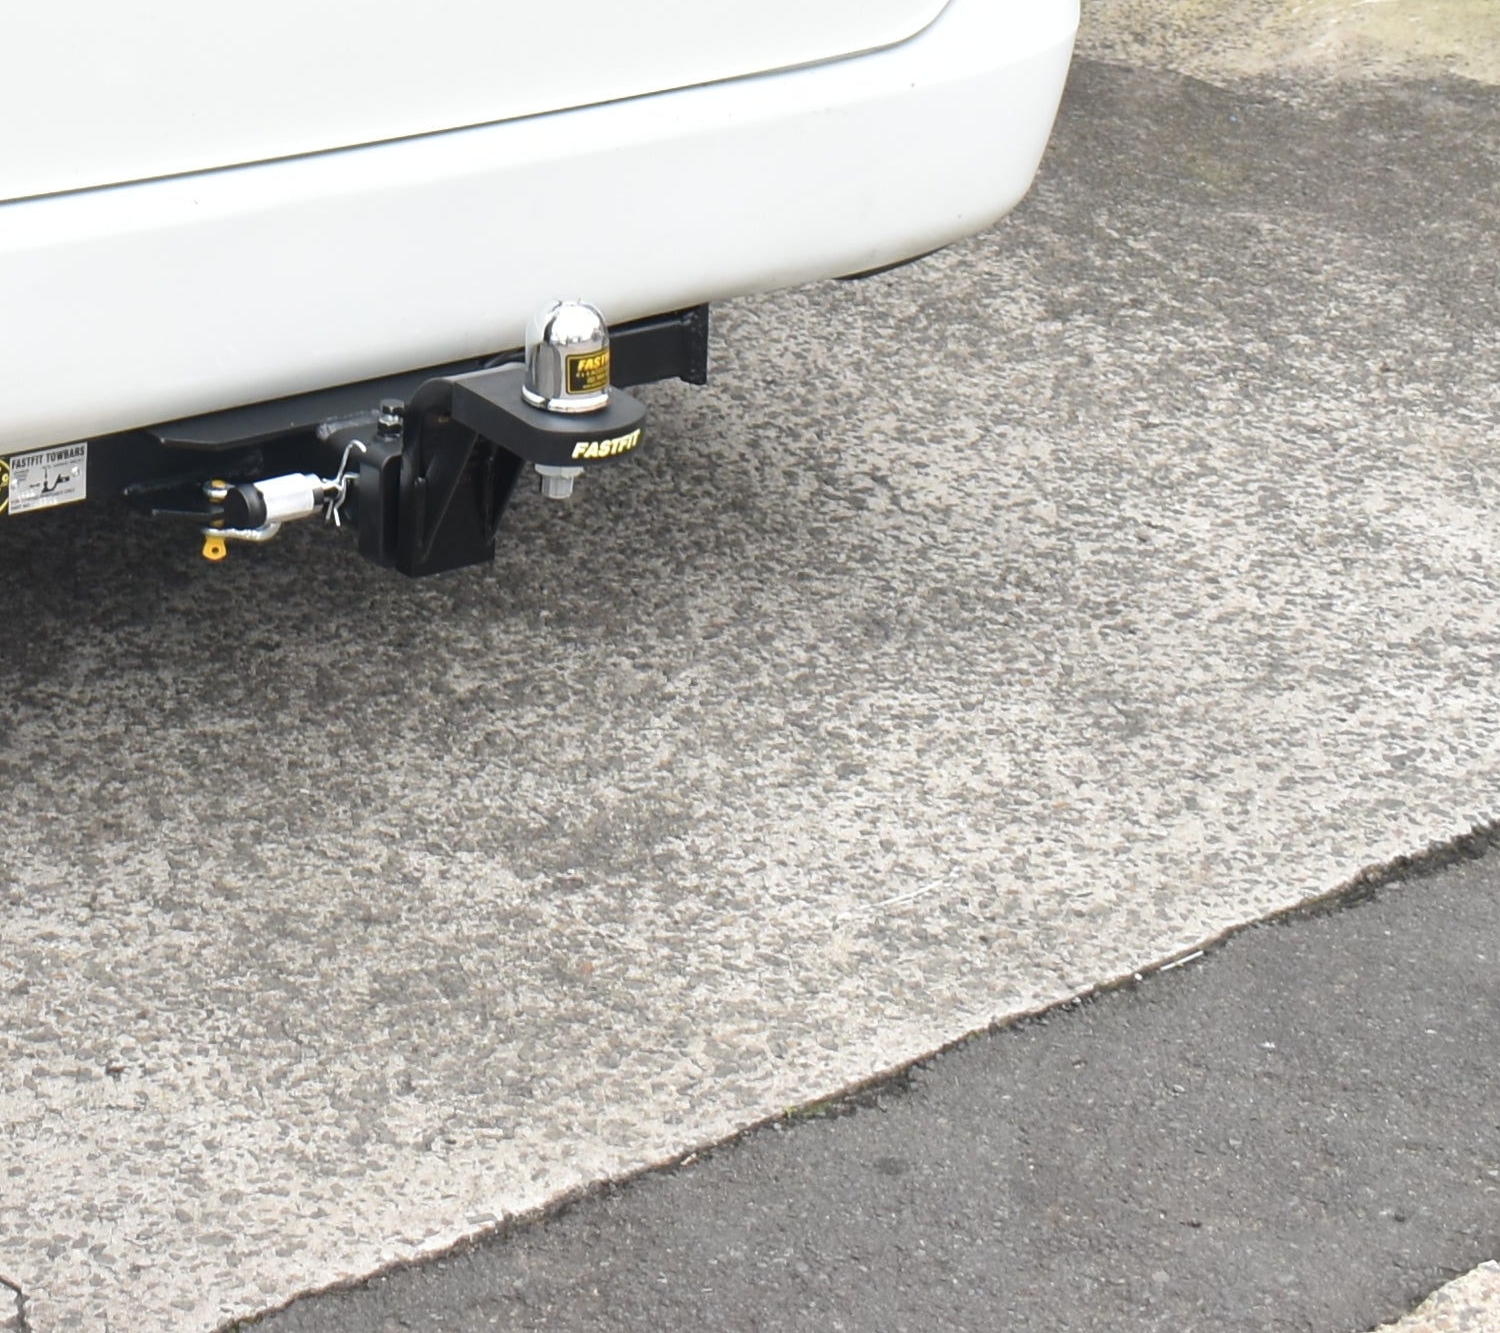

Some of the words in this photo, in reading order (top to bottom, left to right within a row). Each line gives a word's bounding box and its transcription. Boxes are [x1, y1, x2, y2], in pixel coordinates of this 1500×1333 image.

[11, 453, 44, 470] FASTFIT
[46, 445, 85, 463] TOWBARS
[571, 428, 641, 459] FASTFIT
